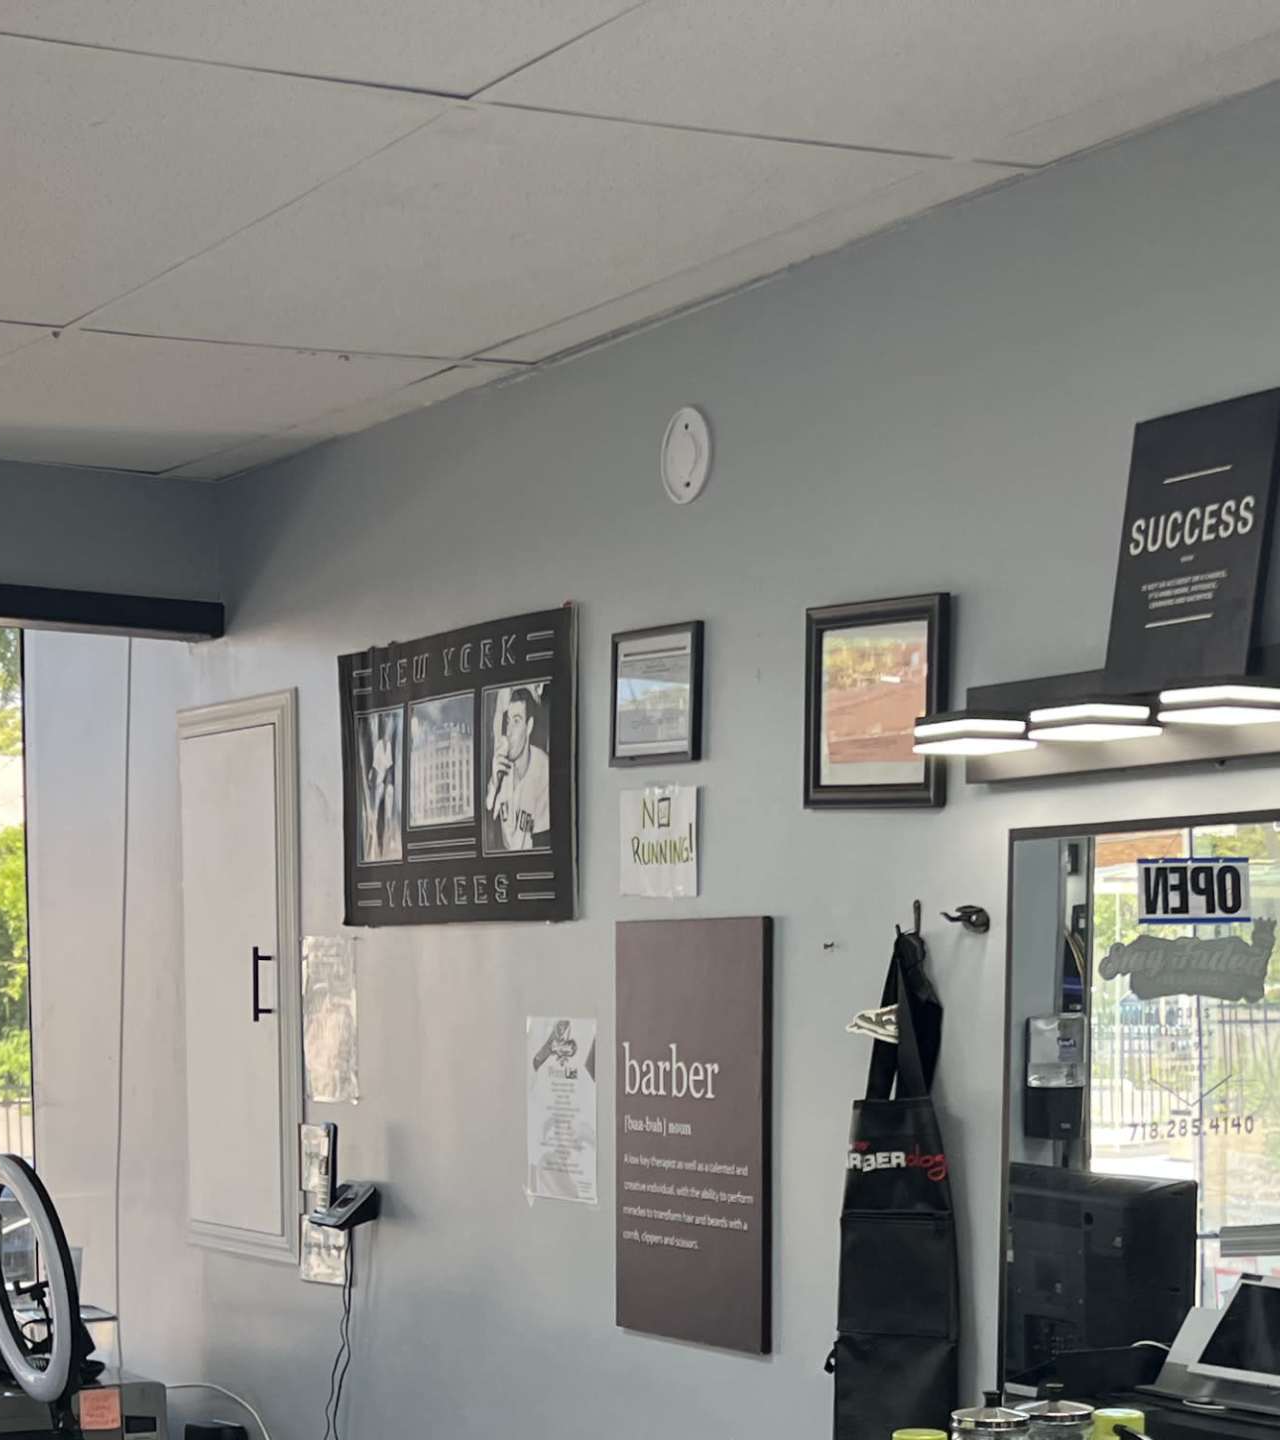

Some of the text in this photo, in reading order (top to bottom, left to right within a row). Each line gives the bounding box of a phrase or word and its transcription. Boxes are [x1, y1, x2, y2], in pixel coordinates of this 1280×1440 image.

[1129, 496, 1255, 556] SUCCESS
[379, 634, 518, 692] NEW YORK
[641, 797, 672, 830] NO
[632, 823, 694, 866] RUNNING!
[386, 874, 510, 908] YANKEES
[623, 1041, 719, 1099] barber
[668, 1123, 692, 1135] noun
[1128, 1115, 1255, 1142] 718.285.4140
[736, 1165, 748, 1176] and
